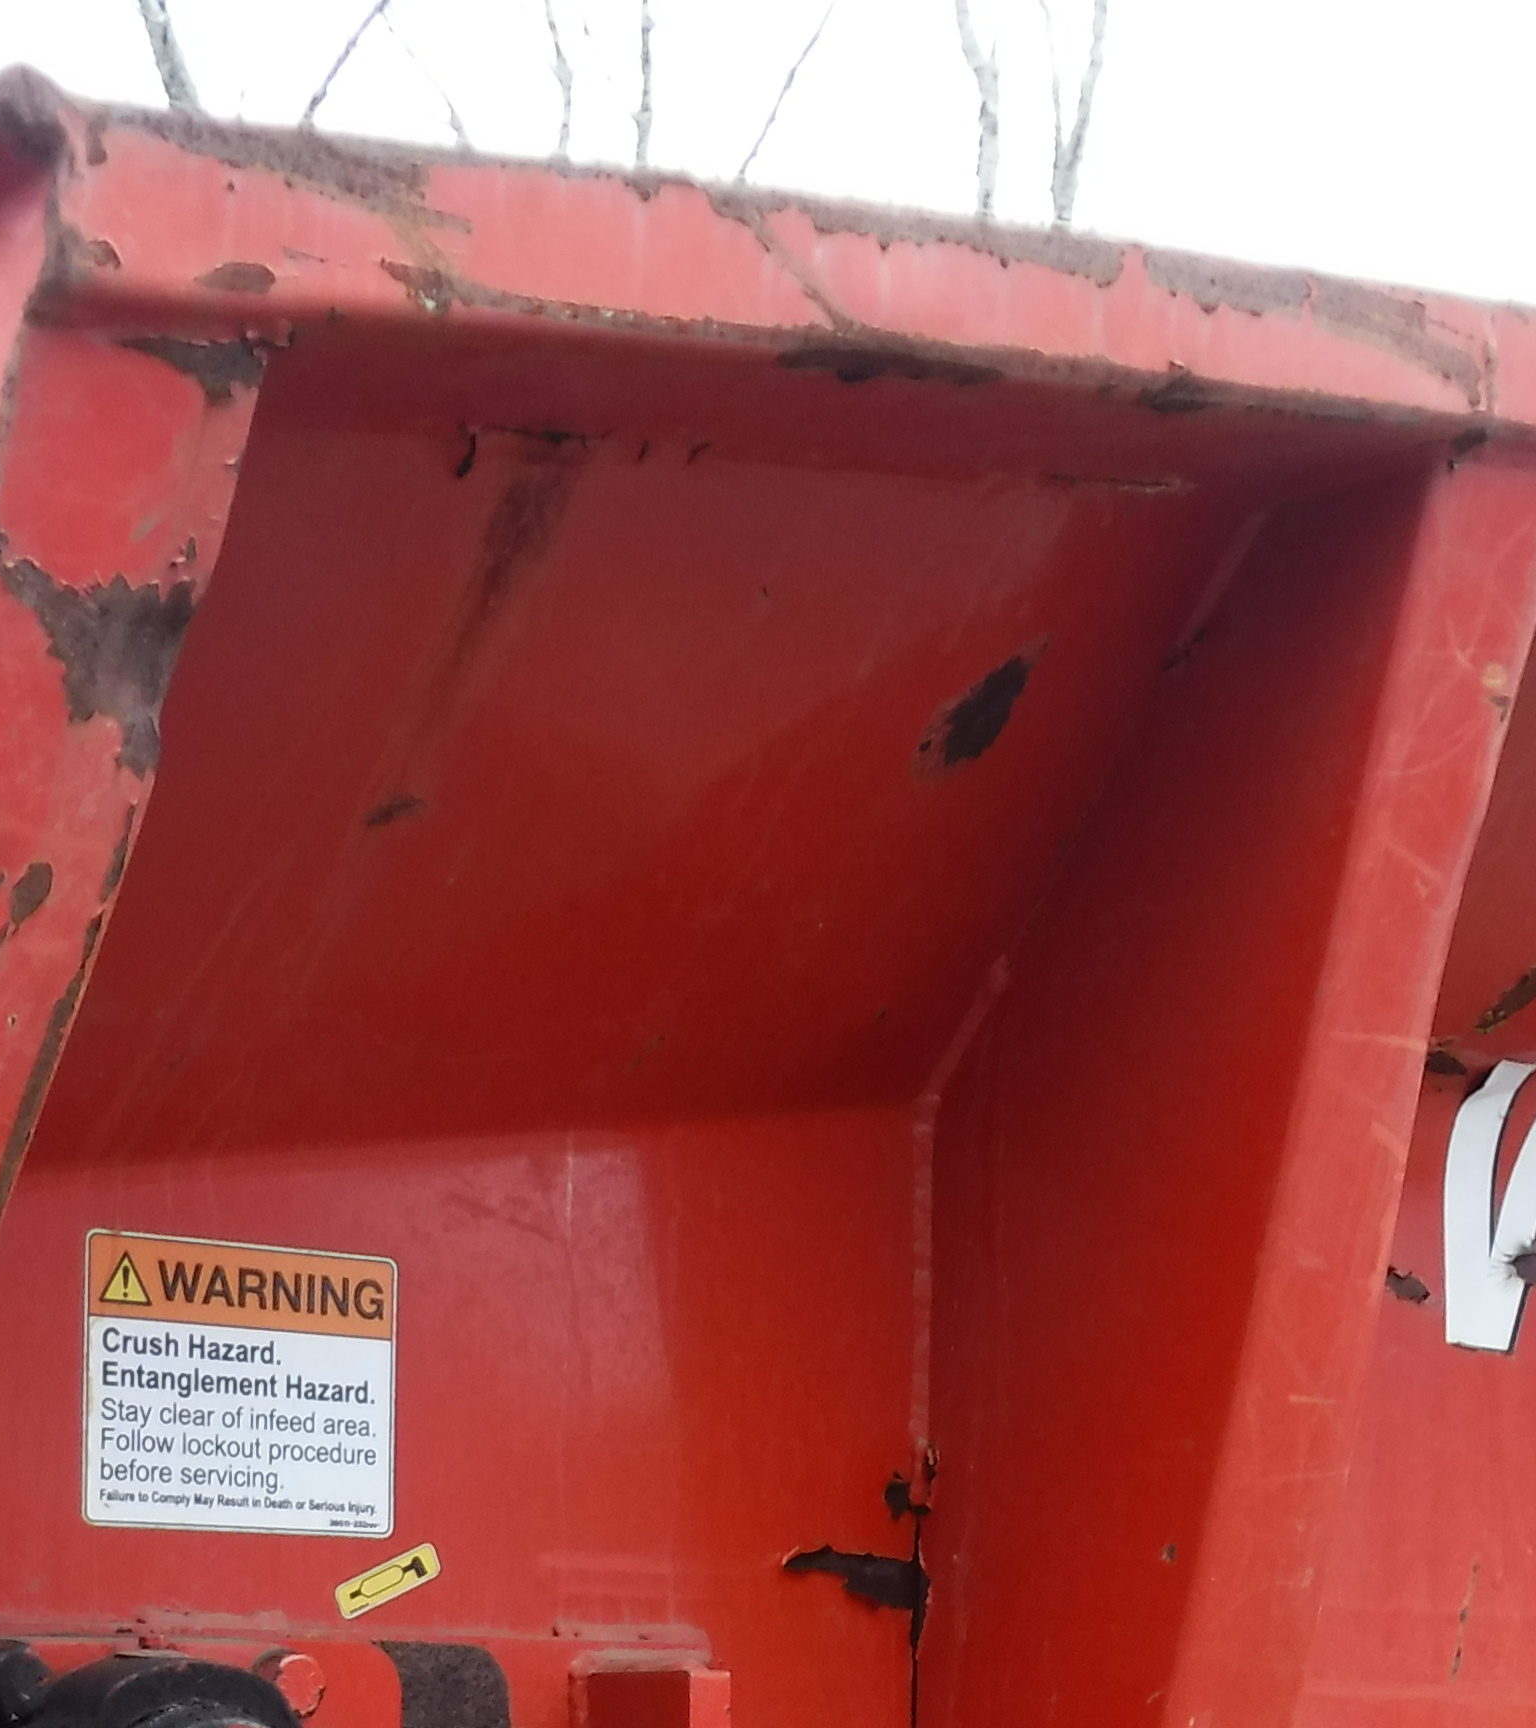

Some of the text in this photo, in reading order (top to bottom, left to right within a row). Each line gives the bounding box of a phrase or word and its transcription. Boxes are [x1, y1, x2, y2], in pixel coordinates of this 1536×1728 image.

[158, 1259, 385, 1321] WARNING
[102, 1327, 282, 1365] Crush Hazard.
[102, 1361, 375, 1405] Entanglement Hazard.
[101, 1398, 376, 1437] Stay clear of infeed area.
[101, 1428, 377, 1466] Follow lockout procedure
[100, 1458, 284, 1494] before servicing.
[100, 1489, 135, 1502] Failure
[138, 1493, 149, 1503] to
[152, 1492, 190, 1508] Comply
[194, 1493, 214, 1508] May
[252, 1496, 261, 1508] in
[264, 1498, 292, 1510] Death
[296, 1501, 306, 1510] or
[309, 1499, 346, 1512] Serious
[348, 1501, 377, 1516] Injury.
